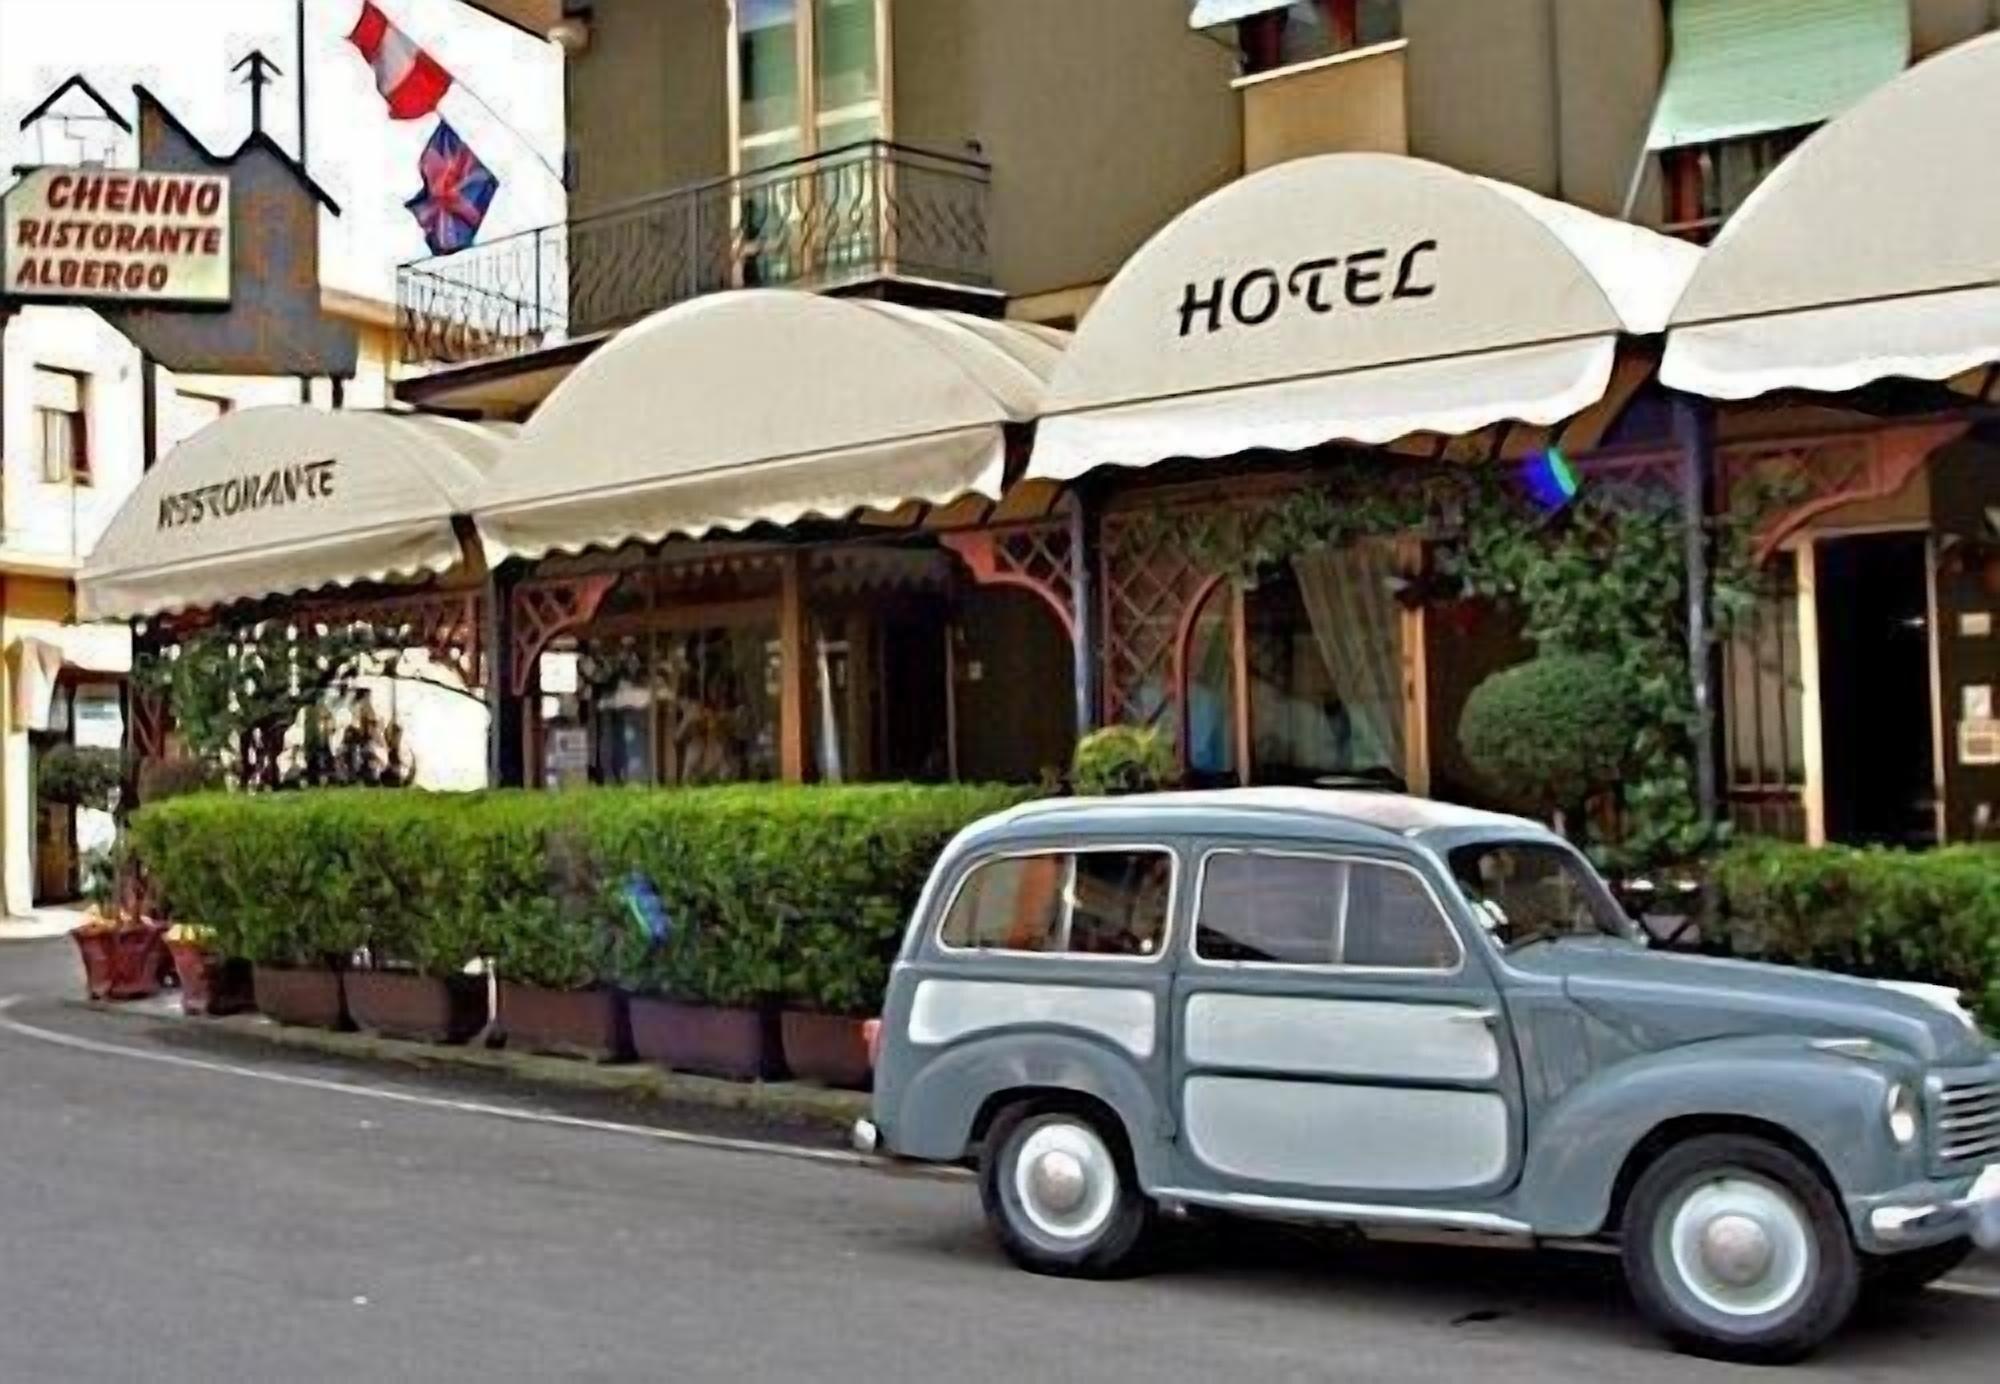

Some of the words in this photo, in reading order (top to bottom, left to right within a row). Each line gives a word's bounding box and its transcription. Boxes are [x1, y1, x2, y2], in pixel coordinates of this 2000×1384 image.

[47, 174, 221, 216] CHENNO
[17, 219, 221, 255] RISTORANTE
[15, 257, 169, 292] ALBERGO
[1177, 239, 1438, 337] HOTEL
